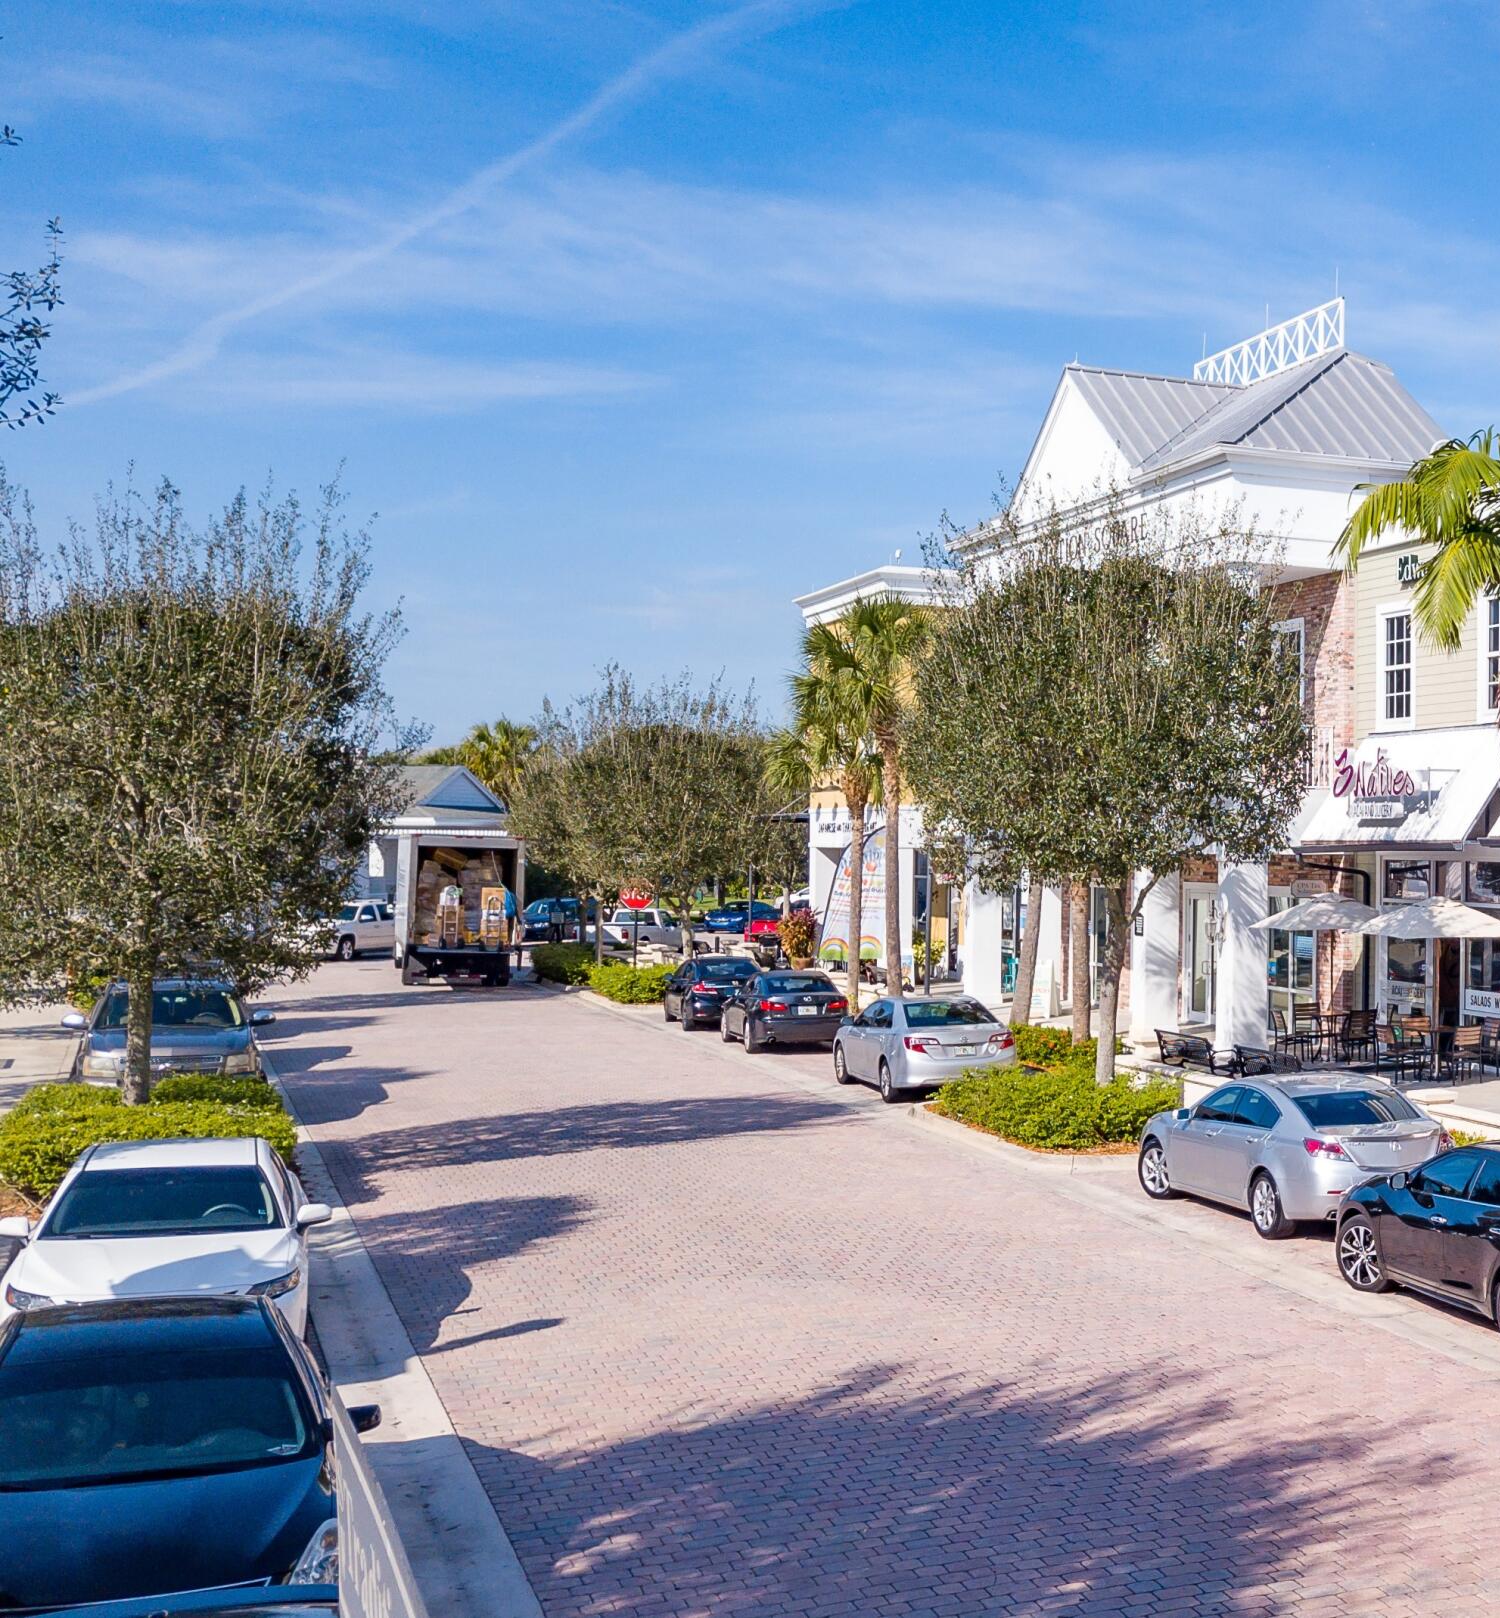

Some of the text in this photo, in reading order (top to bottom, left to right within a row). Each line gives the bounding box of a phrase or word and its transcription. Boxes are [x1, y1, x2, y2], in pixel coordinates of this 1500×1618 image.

[1333, 746, 1415, 798] 3 Natives
[1470, 994, 1492, 1008] SALADS
